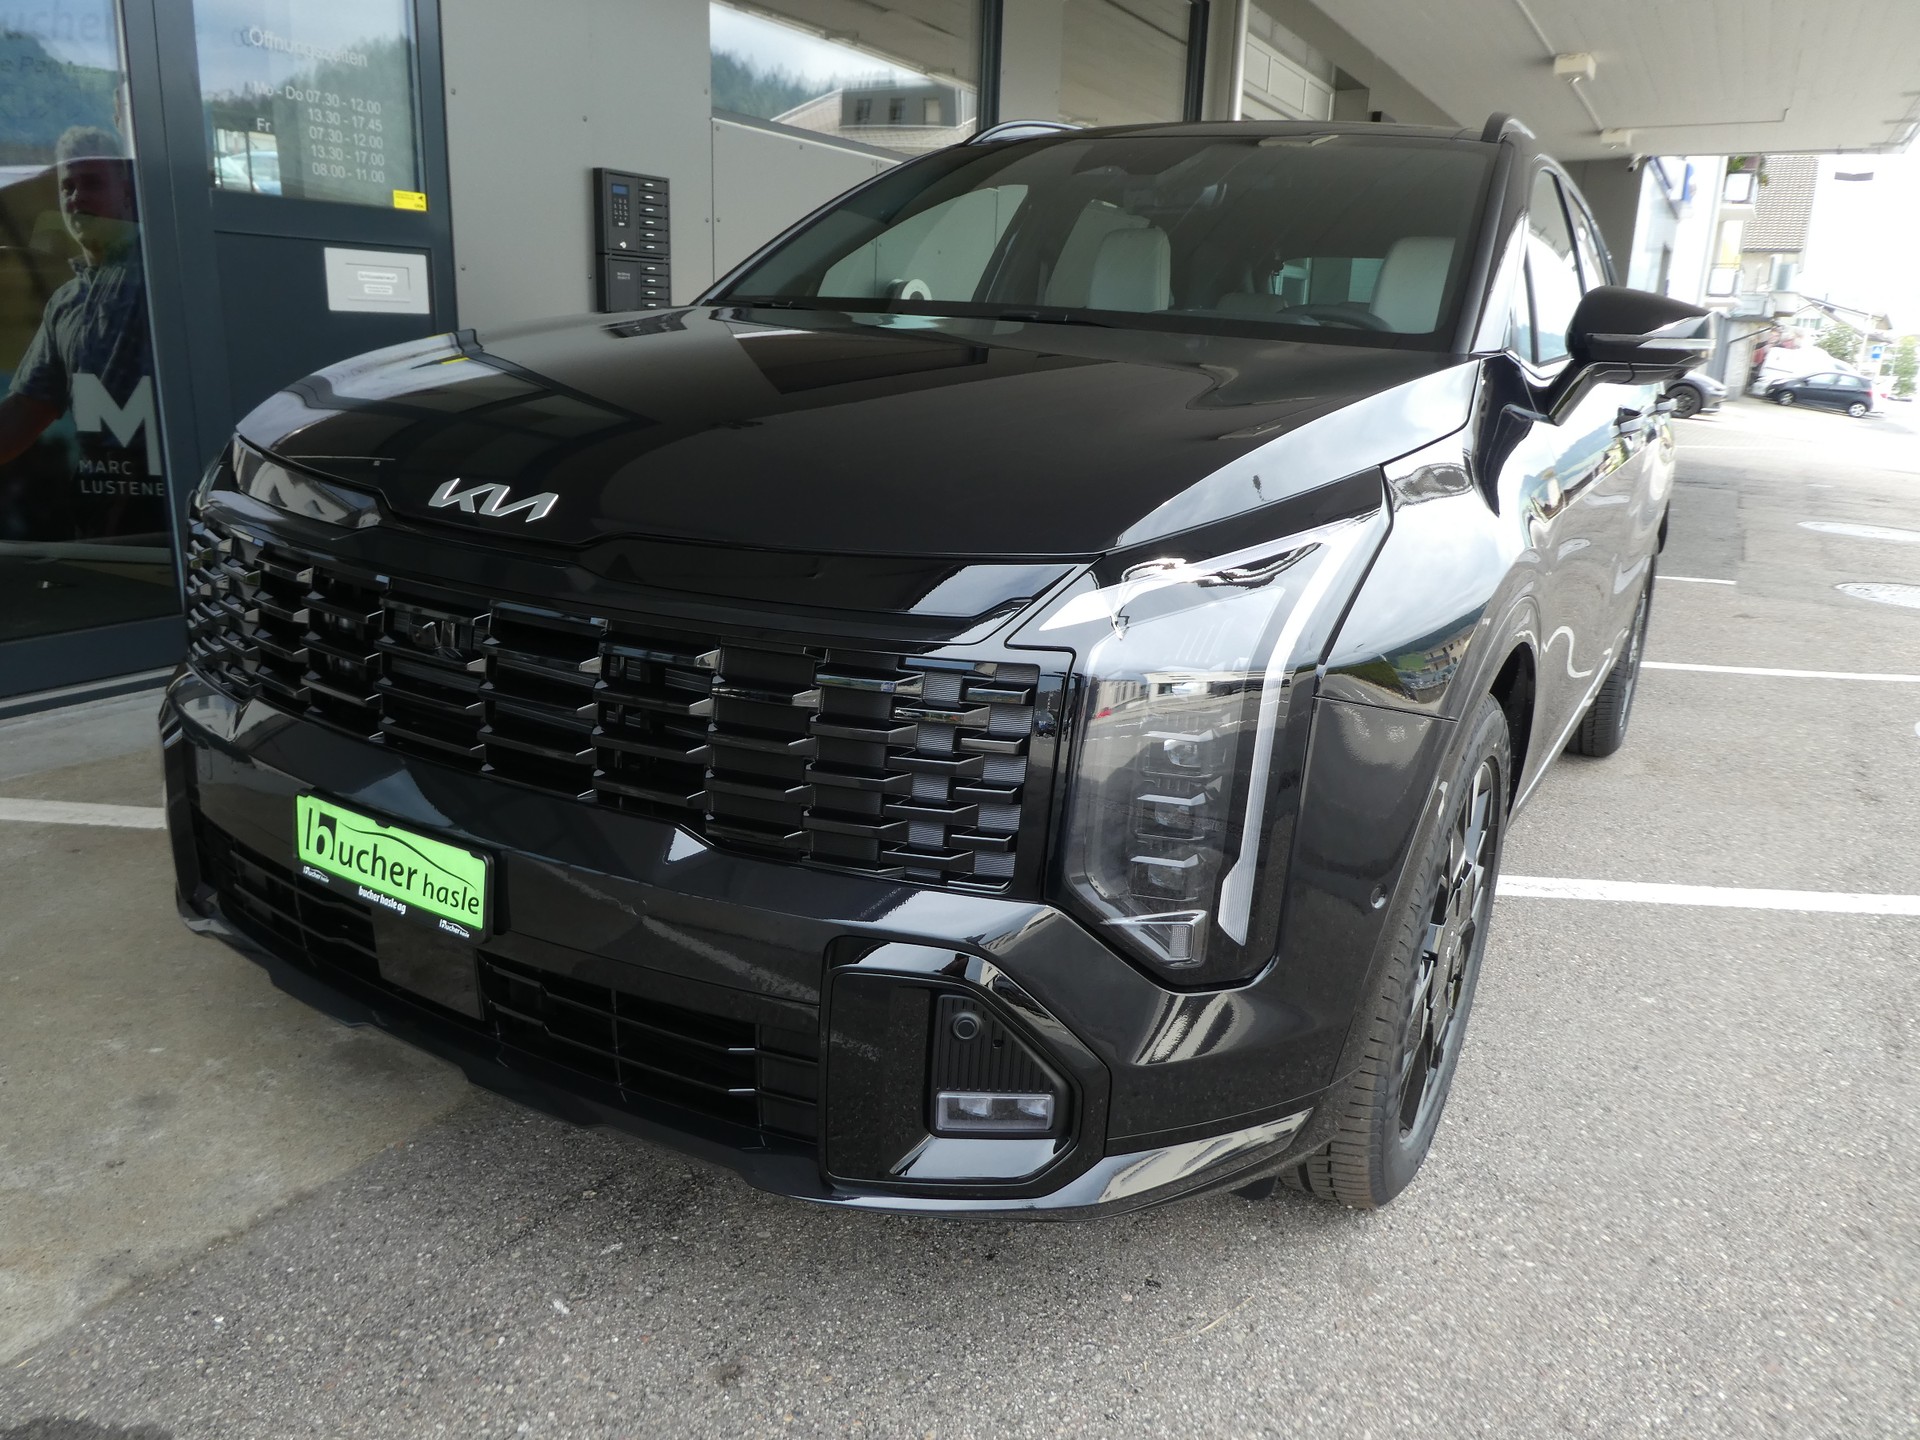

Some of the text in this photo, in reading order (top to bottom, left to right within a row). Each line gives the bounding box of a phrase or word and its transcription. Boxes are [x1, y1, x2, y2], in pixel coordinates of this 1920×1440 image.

[286, 86, 303, 101] Do
[305, 89, 340, 107] 07.30
[350, 98, 381, 114] 12.00
[256, 117, 271, 132] Fr
[308, 125, 343, 143] 07.30
[353, 132, 383, 149] 12.00
[308, 108, 341, 125] 13.30
[351, 115, 383, 132] 17.45
[310, 144, 343, 161] 13.30
[354, 150, 385, 166] 17.00
[312, 162, 345, 178] 08.00
[355, 168, 385, 183] 11.00
[79, 459, 132, 475] MARC
[428, 477, 559, 522] KIA
[305, 807, 480, 915] bucher hasle
[358, 885, 407, 915] bucher hasle ag
